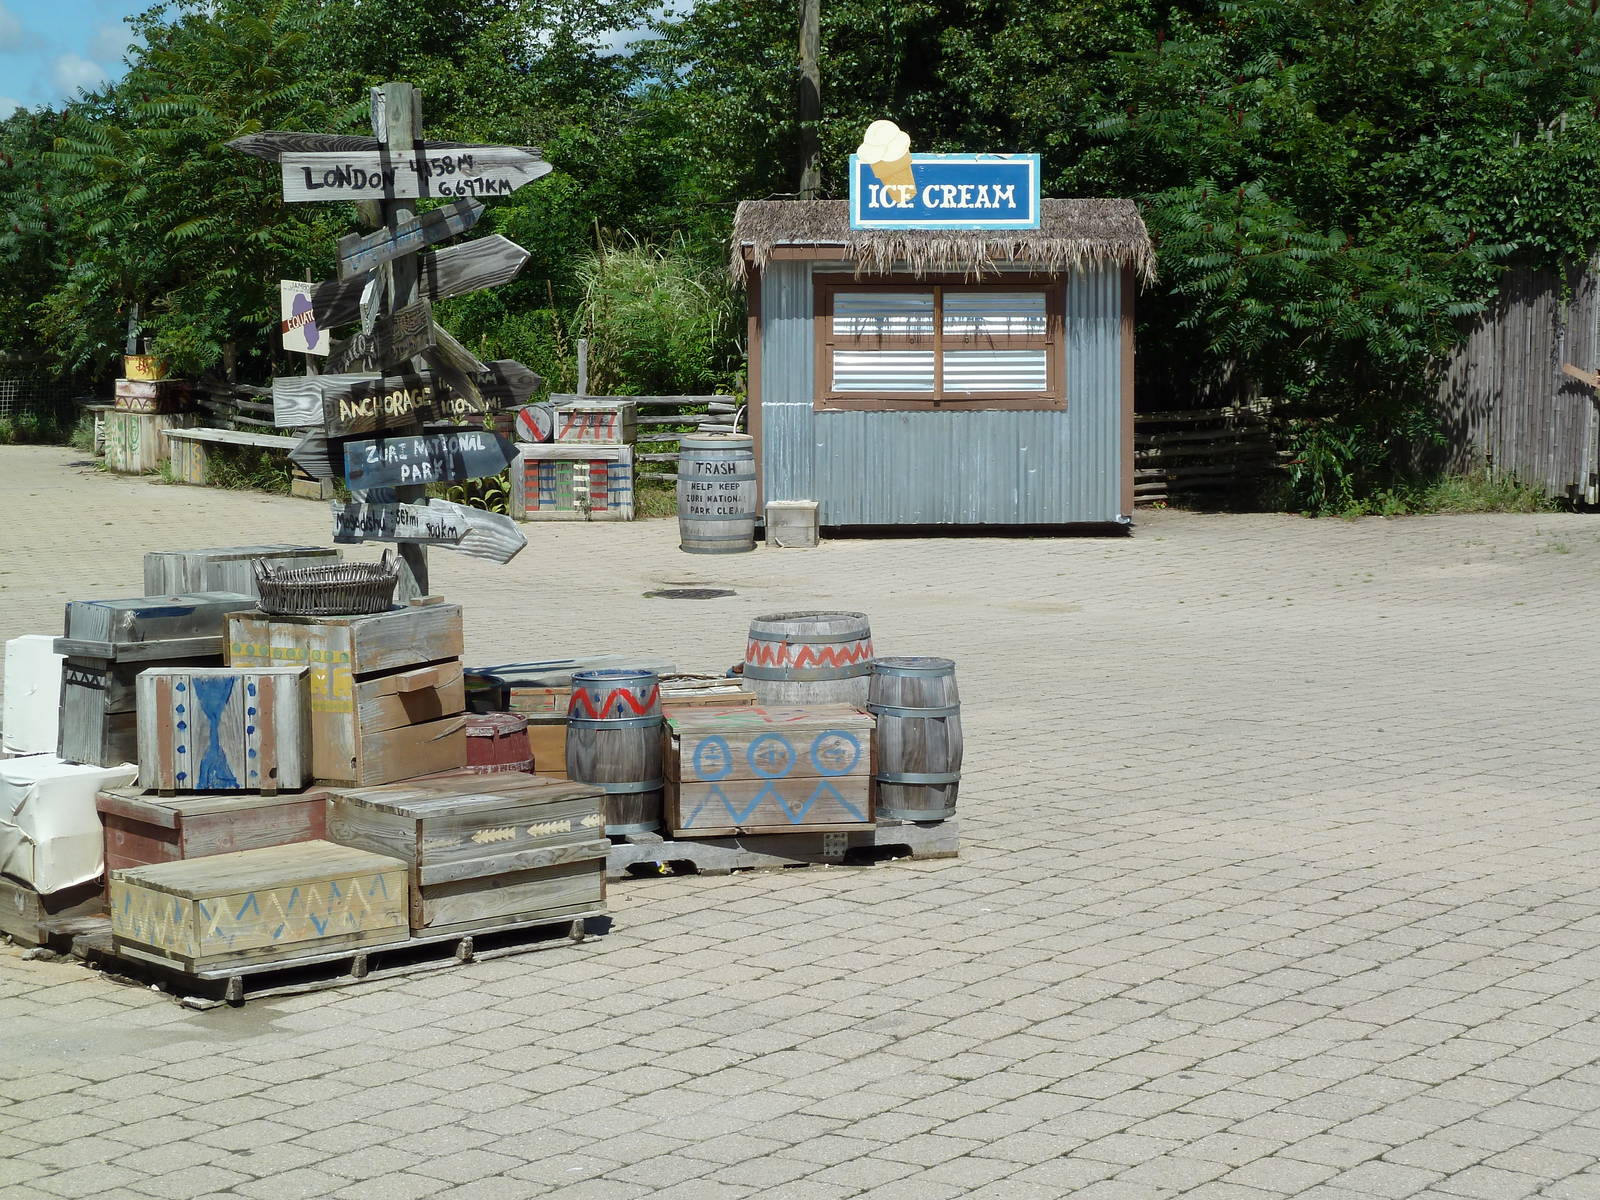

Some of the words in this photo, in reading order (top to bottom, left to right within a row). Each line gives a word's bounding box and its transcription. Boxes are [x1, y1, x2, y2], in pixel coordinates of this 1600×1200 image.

[301, 164, 399, 190] LONDON
[868, 184, 915, 209] ICE
[922, 184, 1017, 209] CREAM
[287, 308, 315, 331] EQUAT
[339, 385, 431, 422] ANCHORAGE
[365, 443, 408, 464] ZURI
[414, 434, 486, 457] NATIONAL
[696, 463, 736, 475] TRASH
[691, 483, 713, 491] HELP
[719, 483, 740, 491] KEEP
[690, 506, 710, 515] PARK
[717, 506, 745, 515] CLEAN
